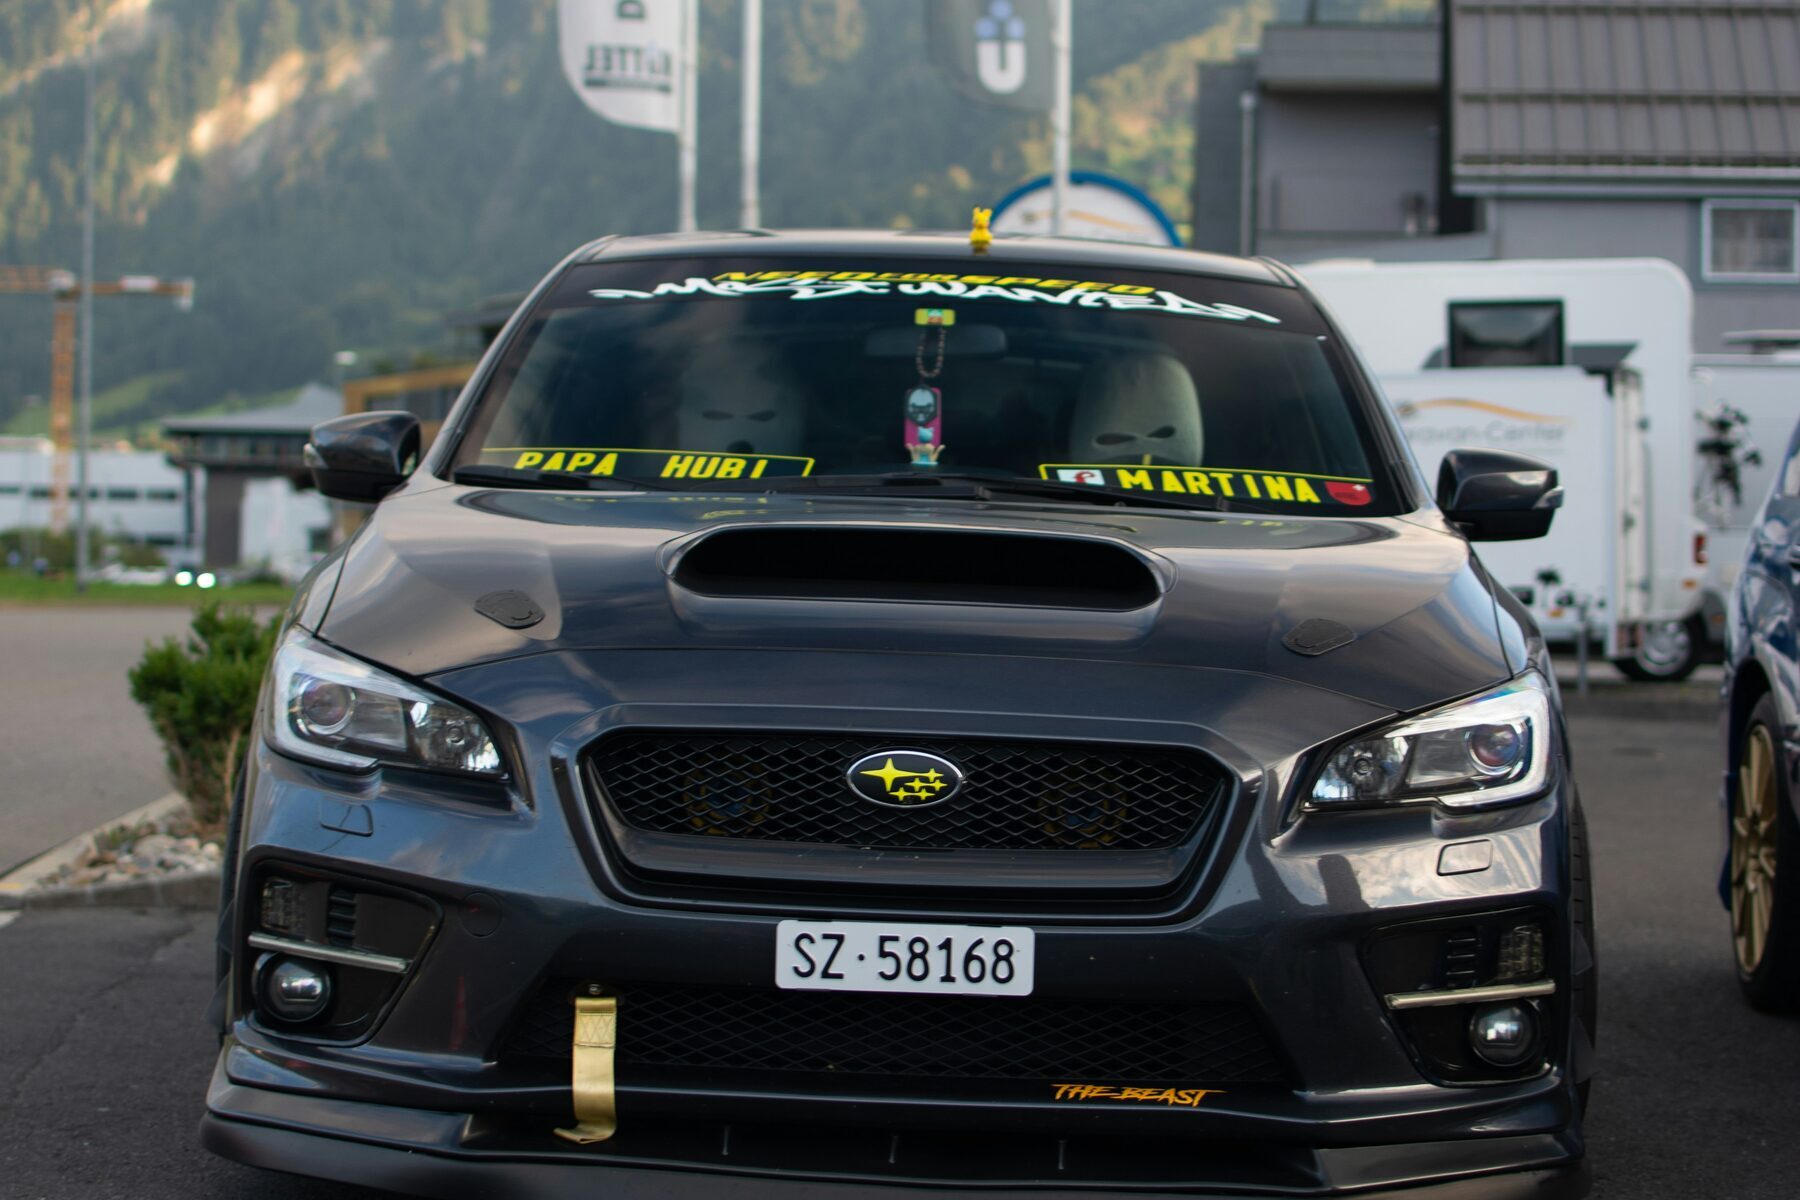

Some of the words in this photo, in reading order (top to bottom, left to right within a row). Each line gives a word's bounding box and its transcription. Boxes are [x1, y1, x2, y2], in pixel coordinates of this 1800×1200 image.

[711, 271, 878, 282] NEED
[958, 275, 1157, 295] SPEED
[514, 451, 618, 476] PAPA
[660, 455, 768, 479] HUBI
[1116, 469, 1321, 503] MARTINA
[1050, 1083, 1120, 1101] THE
[1109, 1086, 1228, 1108] BEAST
